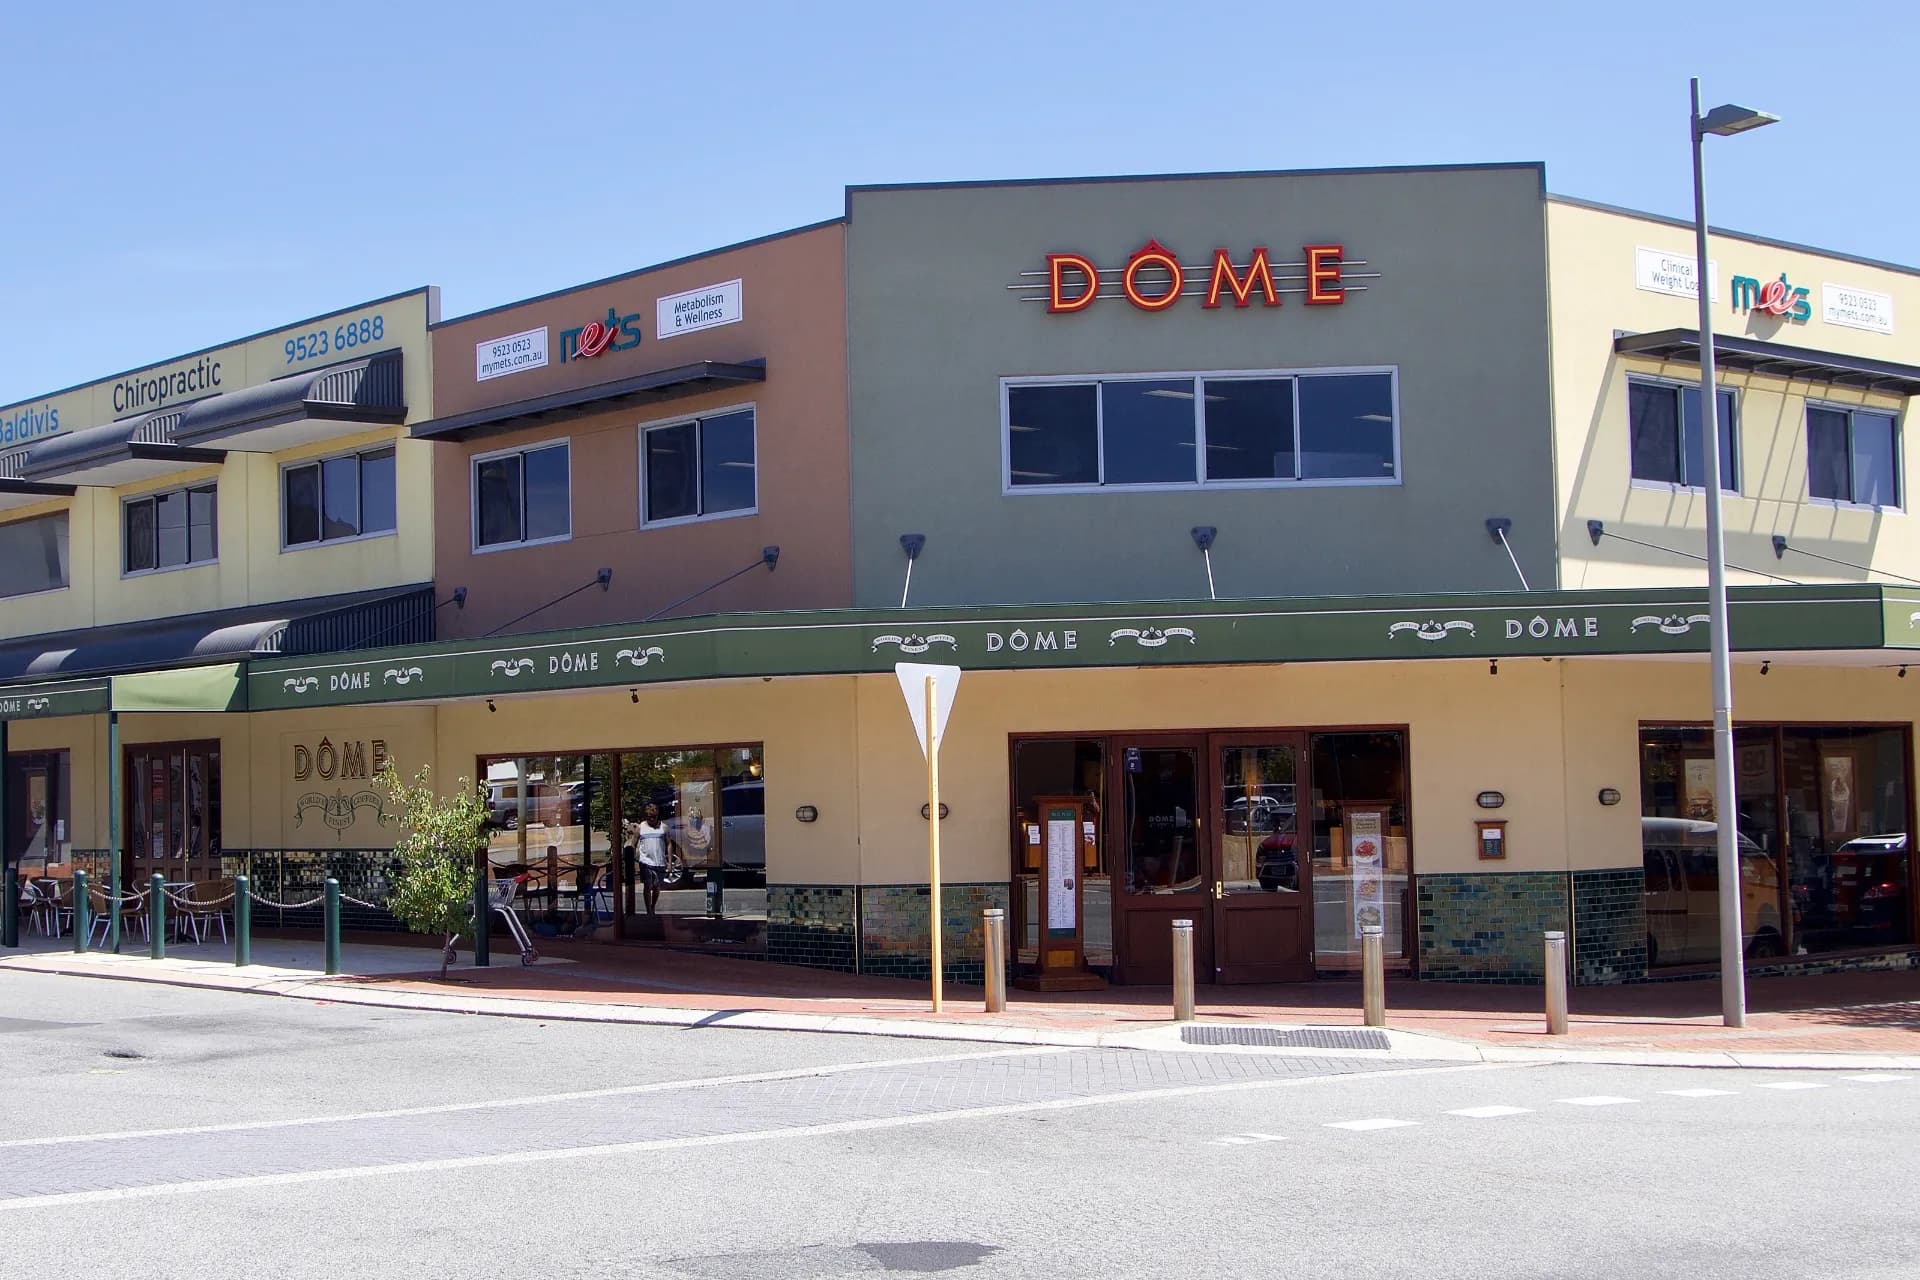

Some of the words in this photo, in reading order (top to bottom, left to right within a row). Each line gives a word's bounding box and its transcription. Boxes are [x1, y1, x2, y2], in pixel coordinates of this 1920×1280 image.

[1046, 238, 1345, 314] DÔME
[1661, 258, 1692, 277] Clinical
[1651, 271, 1682, 289] Weight
[674, 292, 724, 314] Metabolism
[1839, 292, 1858, 307] 9523
[1859, 296, 1877, 311] 0523
[675, 314, 682, 327] &
[684, 307, 723, 324] Wellness
[1828, 306, 1888, 327] mymets.com.au
[492, 342, 510, 358] 9523
[512, 338, 531, 353] 0523
[113, 357, 222, 413] Chiropractic
[285, 330, 329, 364] 9523
[334, 315, 385, 351] 6888
[482, 350, 543, 375] mymets.com.au
[1505, 615, 1598, 639] DÔME
[986, 628, 1078, 652] DÔME
[549, 651, 598, 674] DÔME
[330, 671, 370, 691] DÔME
[294, 735, 387, 781] DÔME
